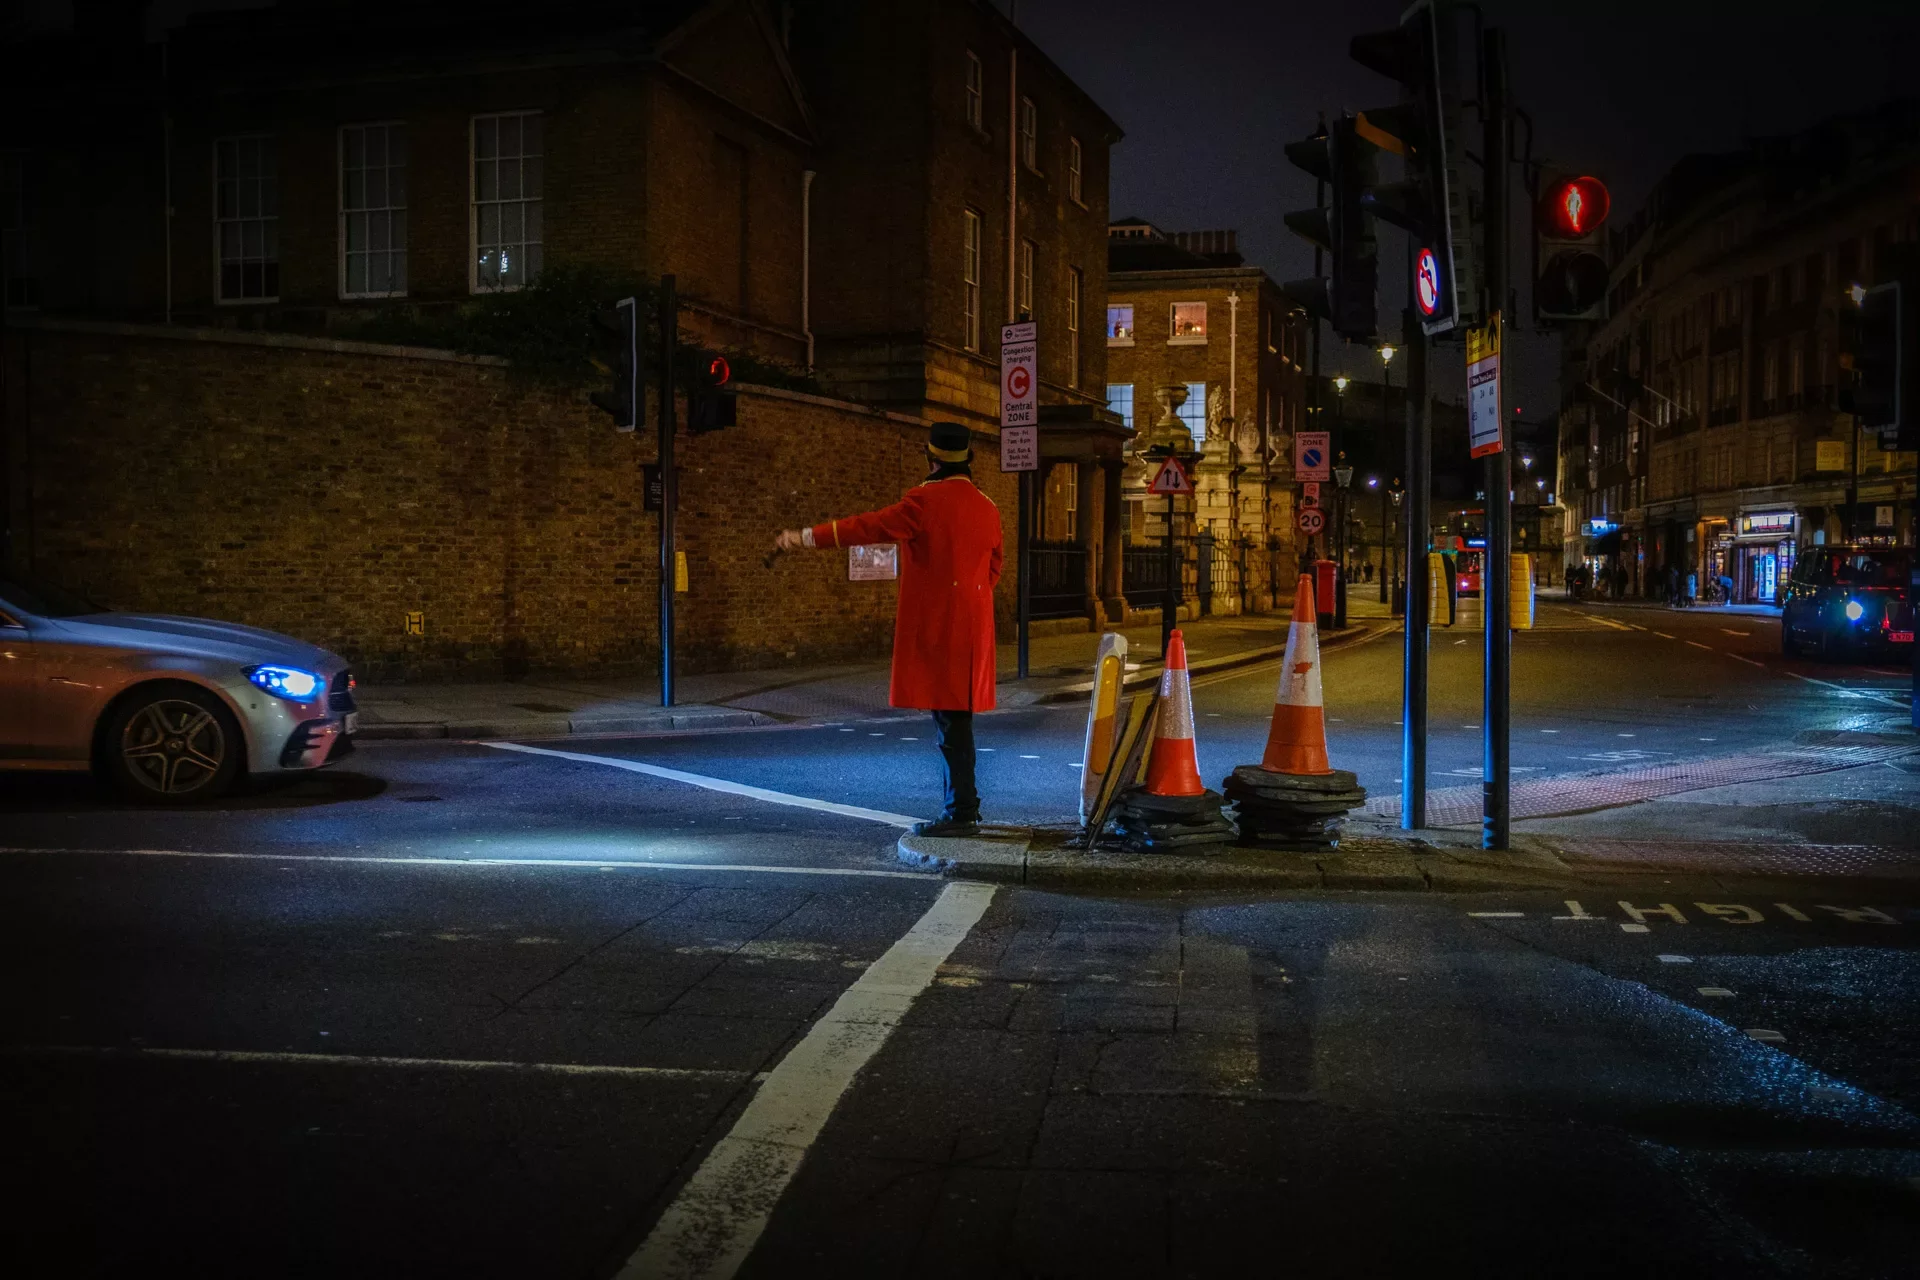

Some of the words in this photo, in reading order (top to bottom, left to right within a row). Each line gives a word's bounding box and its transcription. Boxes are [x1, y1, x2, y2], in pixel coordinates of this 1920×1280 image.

[1003, 345, 1035, 355] Congestion
[1006, 355, 1032, 364] charging
[1005, 402, 1033, 411] Central
[1008, 412, 1030, 421] ZONE
[1301, 515, 1321, 527] 20
[408, 614, 422, 632] H
[1552, 900, 1902, 925] RIGHT
